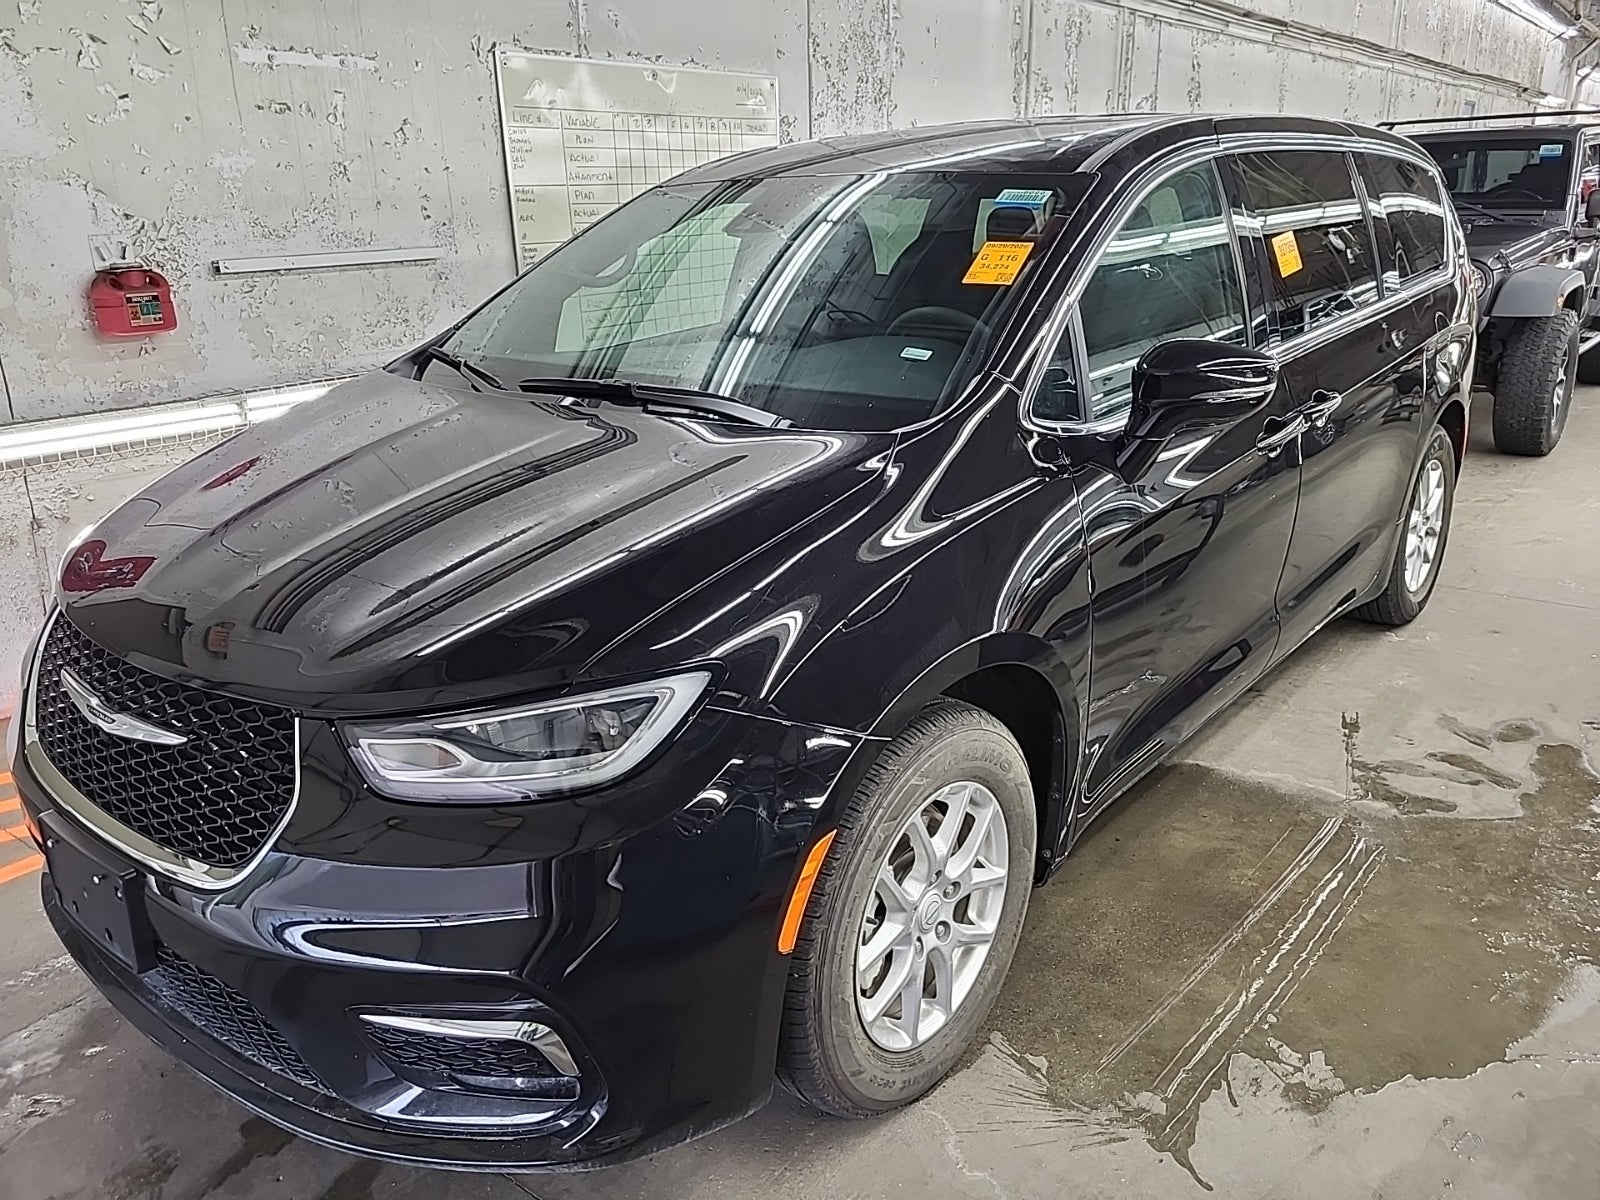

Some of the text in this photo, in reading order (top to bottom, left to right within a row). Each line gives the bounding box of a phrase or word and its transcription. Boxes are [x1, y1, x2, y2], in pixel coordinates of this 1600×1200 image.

[980, 253, 1019, 262] G 116
[978, 263, 1010, 271] 34,274
